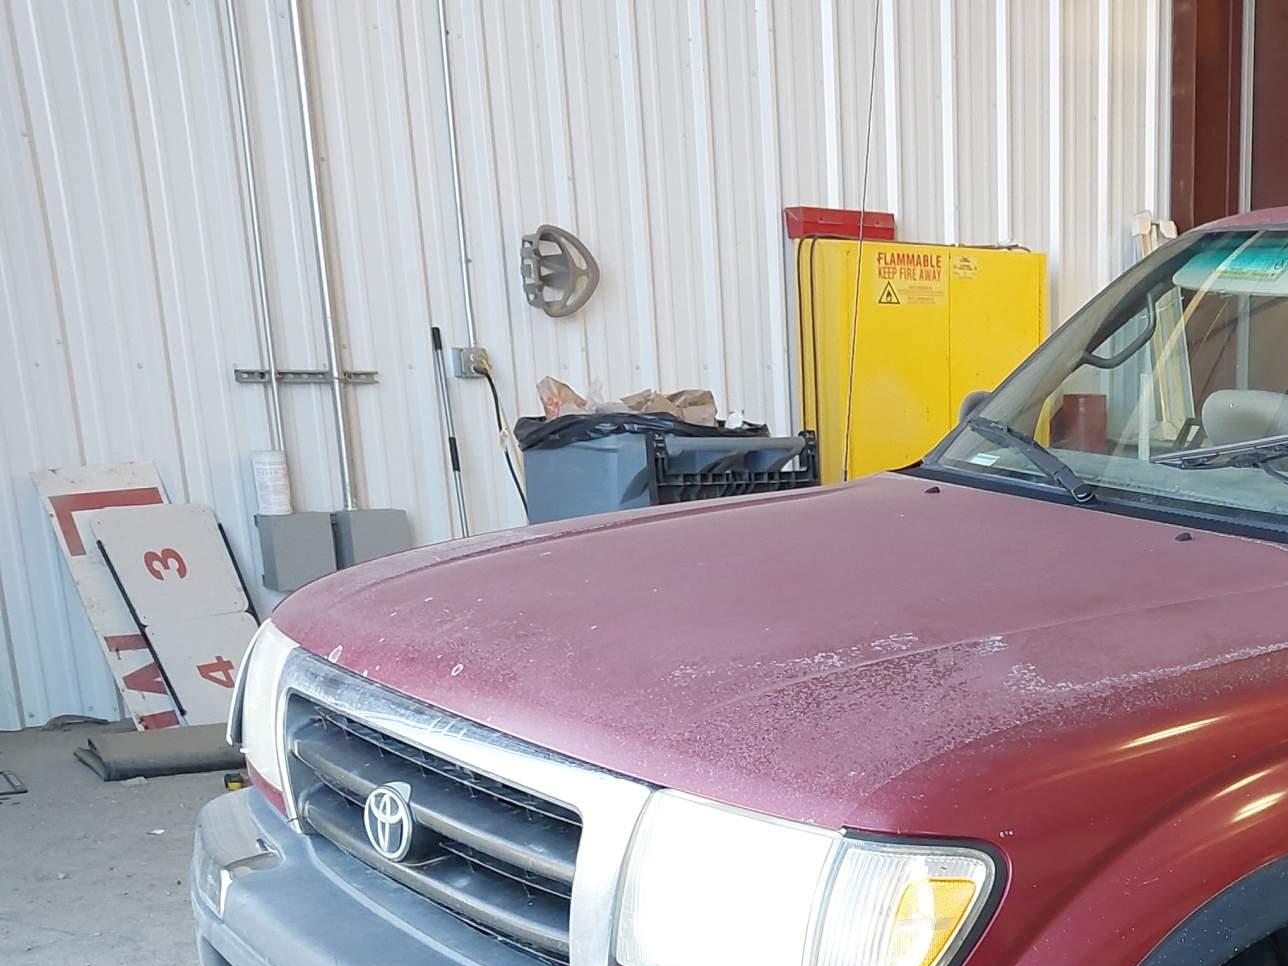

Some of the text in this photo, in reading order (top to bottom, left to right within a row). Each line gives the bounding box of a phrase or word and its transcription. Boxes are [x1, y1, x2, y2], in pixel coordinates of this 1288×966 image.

[877, 252, 942, 268] FLAMMABLE
[878, 267, 897, 280] KEEP
[899, 268, 917, 281] FIRE
[919, 268, 942, 282] AWAY
[143, 547, 188, 581] 3
[196, 655, 236, 689] 4
